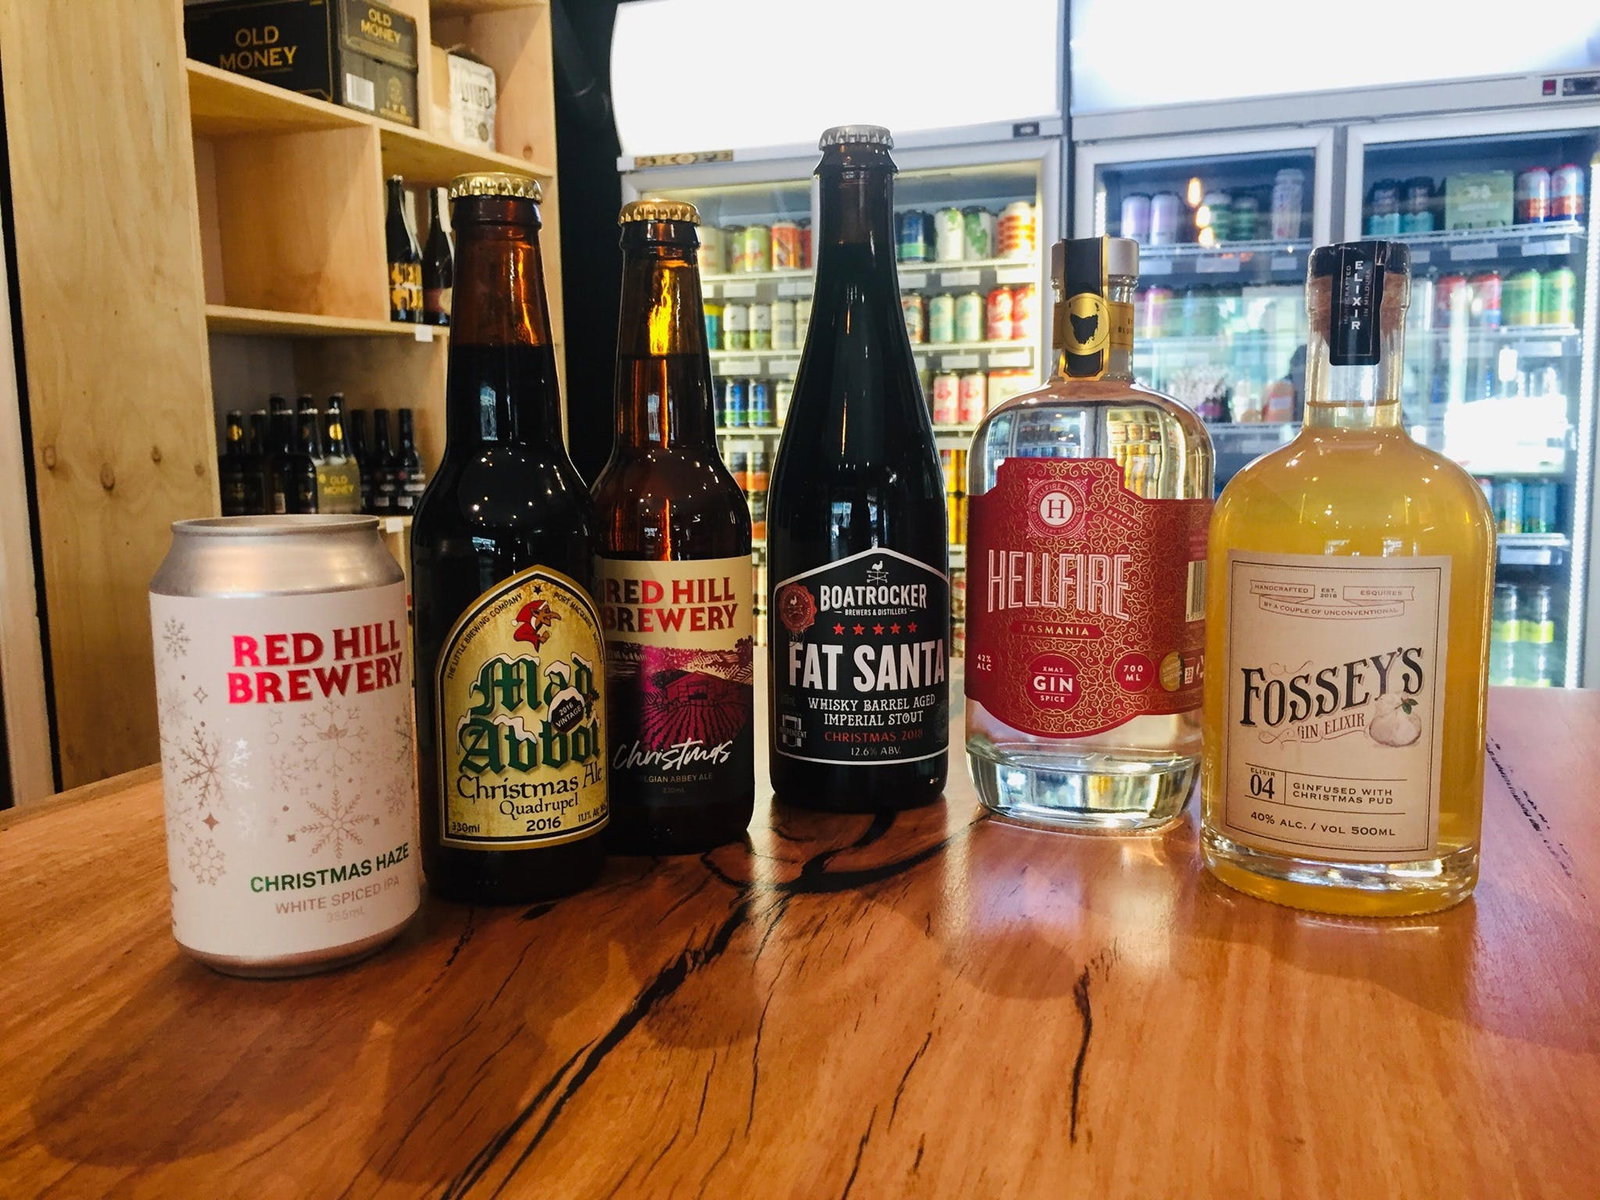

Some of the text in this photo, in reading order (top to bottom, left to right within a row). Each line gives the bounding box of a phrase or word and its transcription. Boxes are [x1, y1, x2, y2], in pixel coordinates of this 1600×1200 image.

[368, 8, 392, 28] OLD
[235, 25, 279, 47] OLD
[361, 19, 401, 44] MONEY
[220, 45, 298, 70] MONEY
[1351, 260, 1364, 330] ELIXIR
[1047, 499, 1066, 519] H
[1107, 509, 1133, 528] BATCH
[604, 577, 735, 605] RED HILL
[987, 549, 1133, 622] HELLFIRE
[1254, 584, 1309, 594] HANDCRAFTED
[553, 591, 570, 606] PORT
[820, 583, 927, 612] BOATROCKER
[602, 603, 738, 633] BREWERY
[844, 607, 908, 617] BREWERS & DISTILLERS
[1280, 605, 1309, 614] COUPLE
[1324, 608, 1399, 616] UNCONVENTIONAL
[447, 592, 523, 680] THE LITTLE BREWING COMPANY
[1021, 624, 1089, 636] TASMANIA
[232, 620, 401, 667] RED HILL
[788, 638, 945, 693] FAT SANTA
[977, 654, 991, 663] 42%
[977, 662, 992, 672] ALC
[1123, 664, 1144, 673] 700
[227, 651, 403, 704] BREWERY
[469, 652, 594, 716] Mad
[1033, 676, 1073, 693] GIN
[1125, 674, 1141, 682] ML
[1240, 646, 1423, 726] FOSSEY'S
[808, 697, 858, 711] WHISKY
[863, 697, 910, 712] BARREL
[913, 693, 936, 708] AGED
[1040, 694, 1065, 703] SPICE
[555, 704, 582, 729] VINTAGE
[558, 702, 574, 717] 2016
[824, 710, 924, 727] IMPERIAL STOUT
[1297, 712, 1366, 740] GIN ELIXIR
[824, 731, 897, 743] CHRISTMAS
[612, 737, 733, 771] Christmas
[880, 746, 901, 756] ABV
[670, 774, 696, 783] ABBEY
[699, 772, 713, 781] ALE
[1250, 767, 1276, 777] ELIXIR
[457, 761, 602, 804] Christmas Ale
[1250, 774, 1276, 800] 04
[1293, 782, 1393, 797] GINFUSED WITH
[499, 792, 579, 820] Quadrupel
[1293, 790, 1394, 805] CHRISTMAS PUD
[452, 821, 480, 833] 330ml
[526, 815, 562, 833] 2016
[1250, 811, 1276, 825] 40%
[1280, 820, 1307, 830] ALC.
[1320, 825, 1346, 835] VOL
[1351, 826, 1396, 836] 500ML
[250, 842, 409, 893] CHRISTMAS HAZE
[275, 875, 400, 915] WHITE SPICED IPA
